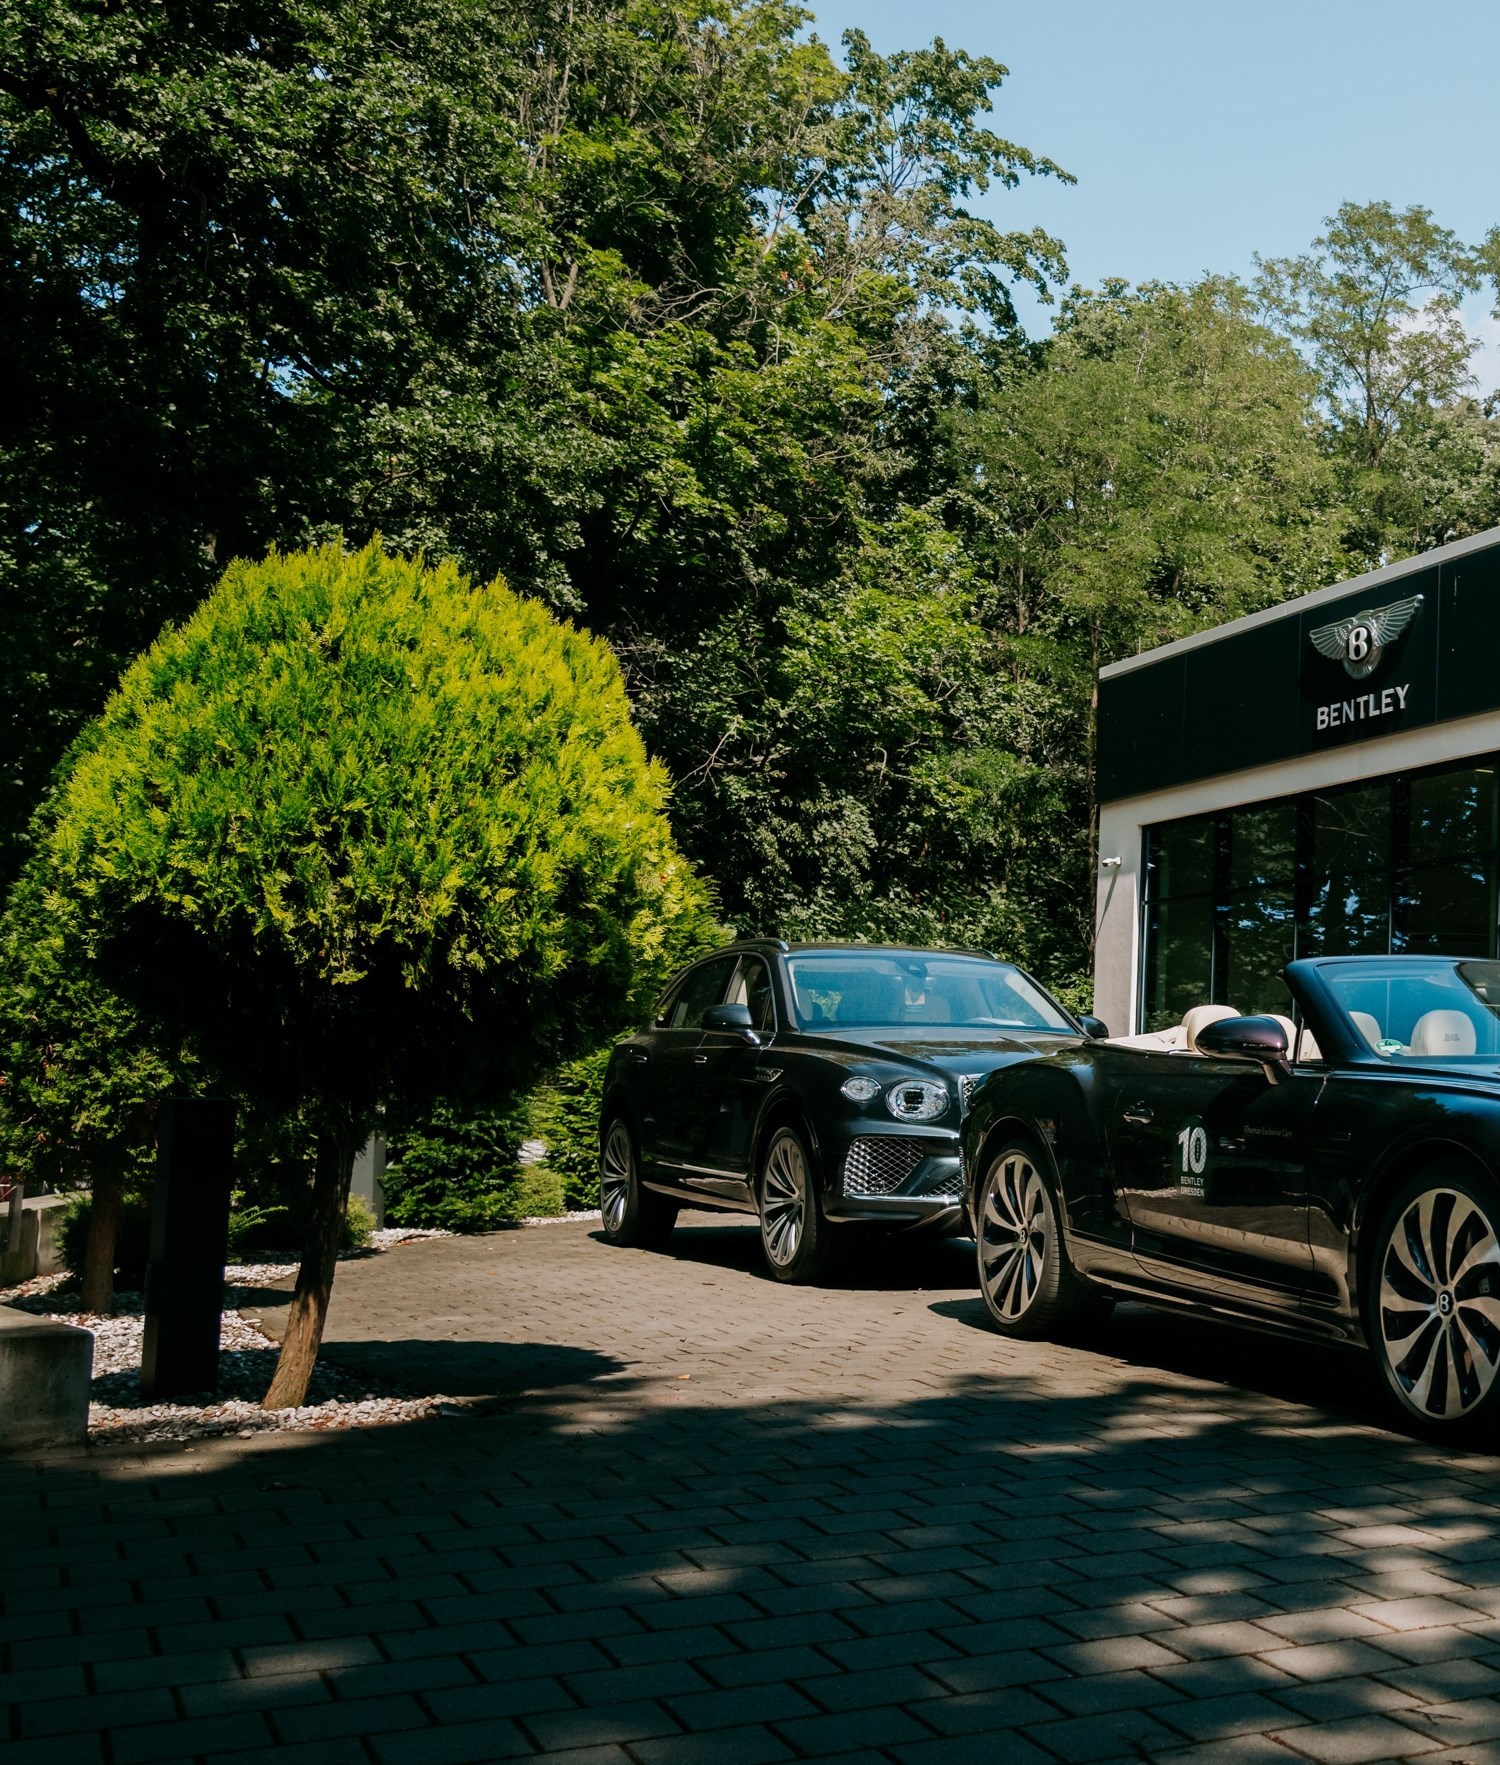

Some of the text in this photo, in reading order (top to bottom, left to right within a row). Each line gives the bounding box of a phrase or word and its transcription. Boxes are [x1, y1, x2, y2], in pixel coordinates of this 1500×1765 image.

[1349, 627, 1368, 661] B
[1316, 683, 1410, 730] BENTLEY
[1178, 1126, 1207, 1174] 10
[1181, 1176, 1204, 1186] BENTLEY
[1181, 1186, 1205, 1197] DRESDEN
